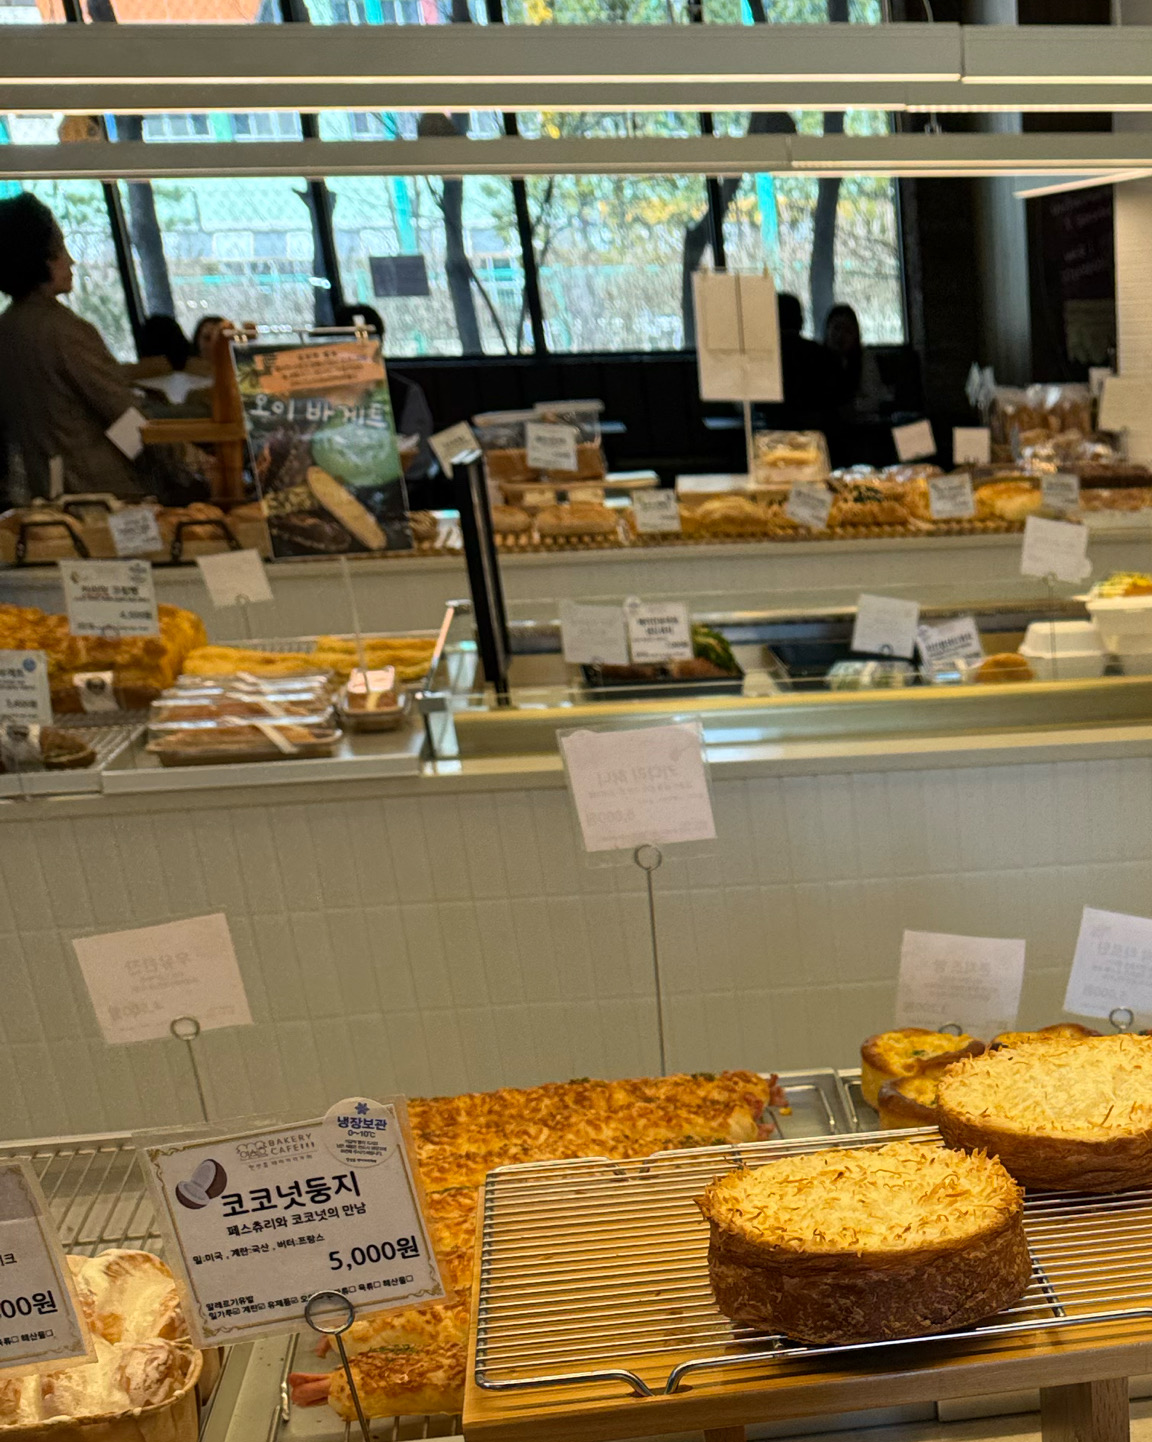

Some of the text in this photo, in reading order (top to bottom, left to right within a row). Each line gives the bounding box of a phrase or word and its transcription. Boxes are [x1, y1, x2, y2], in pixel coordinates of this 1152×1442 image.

[250, 394, 295, 421] 오이
[337, 1116, 387, 1131] 냉장보관
[268, 1133, 311, 1147] BAKERY
[222, 1170, 361, 1218] 코코넛둥지
[292, 1208, 340, 1227] 코코넛의
[342, 1202, 366, 1219] 만남
[329, 1235, 421, 1271] 5,000원
